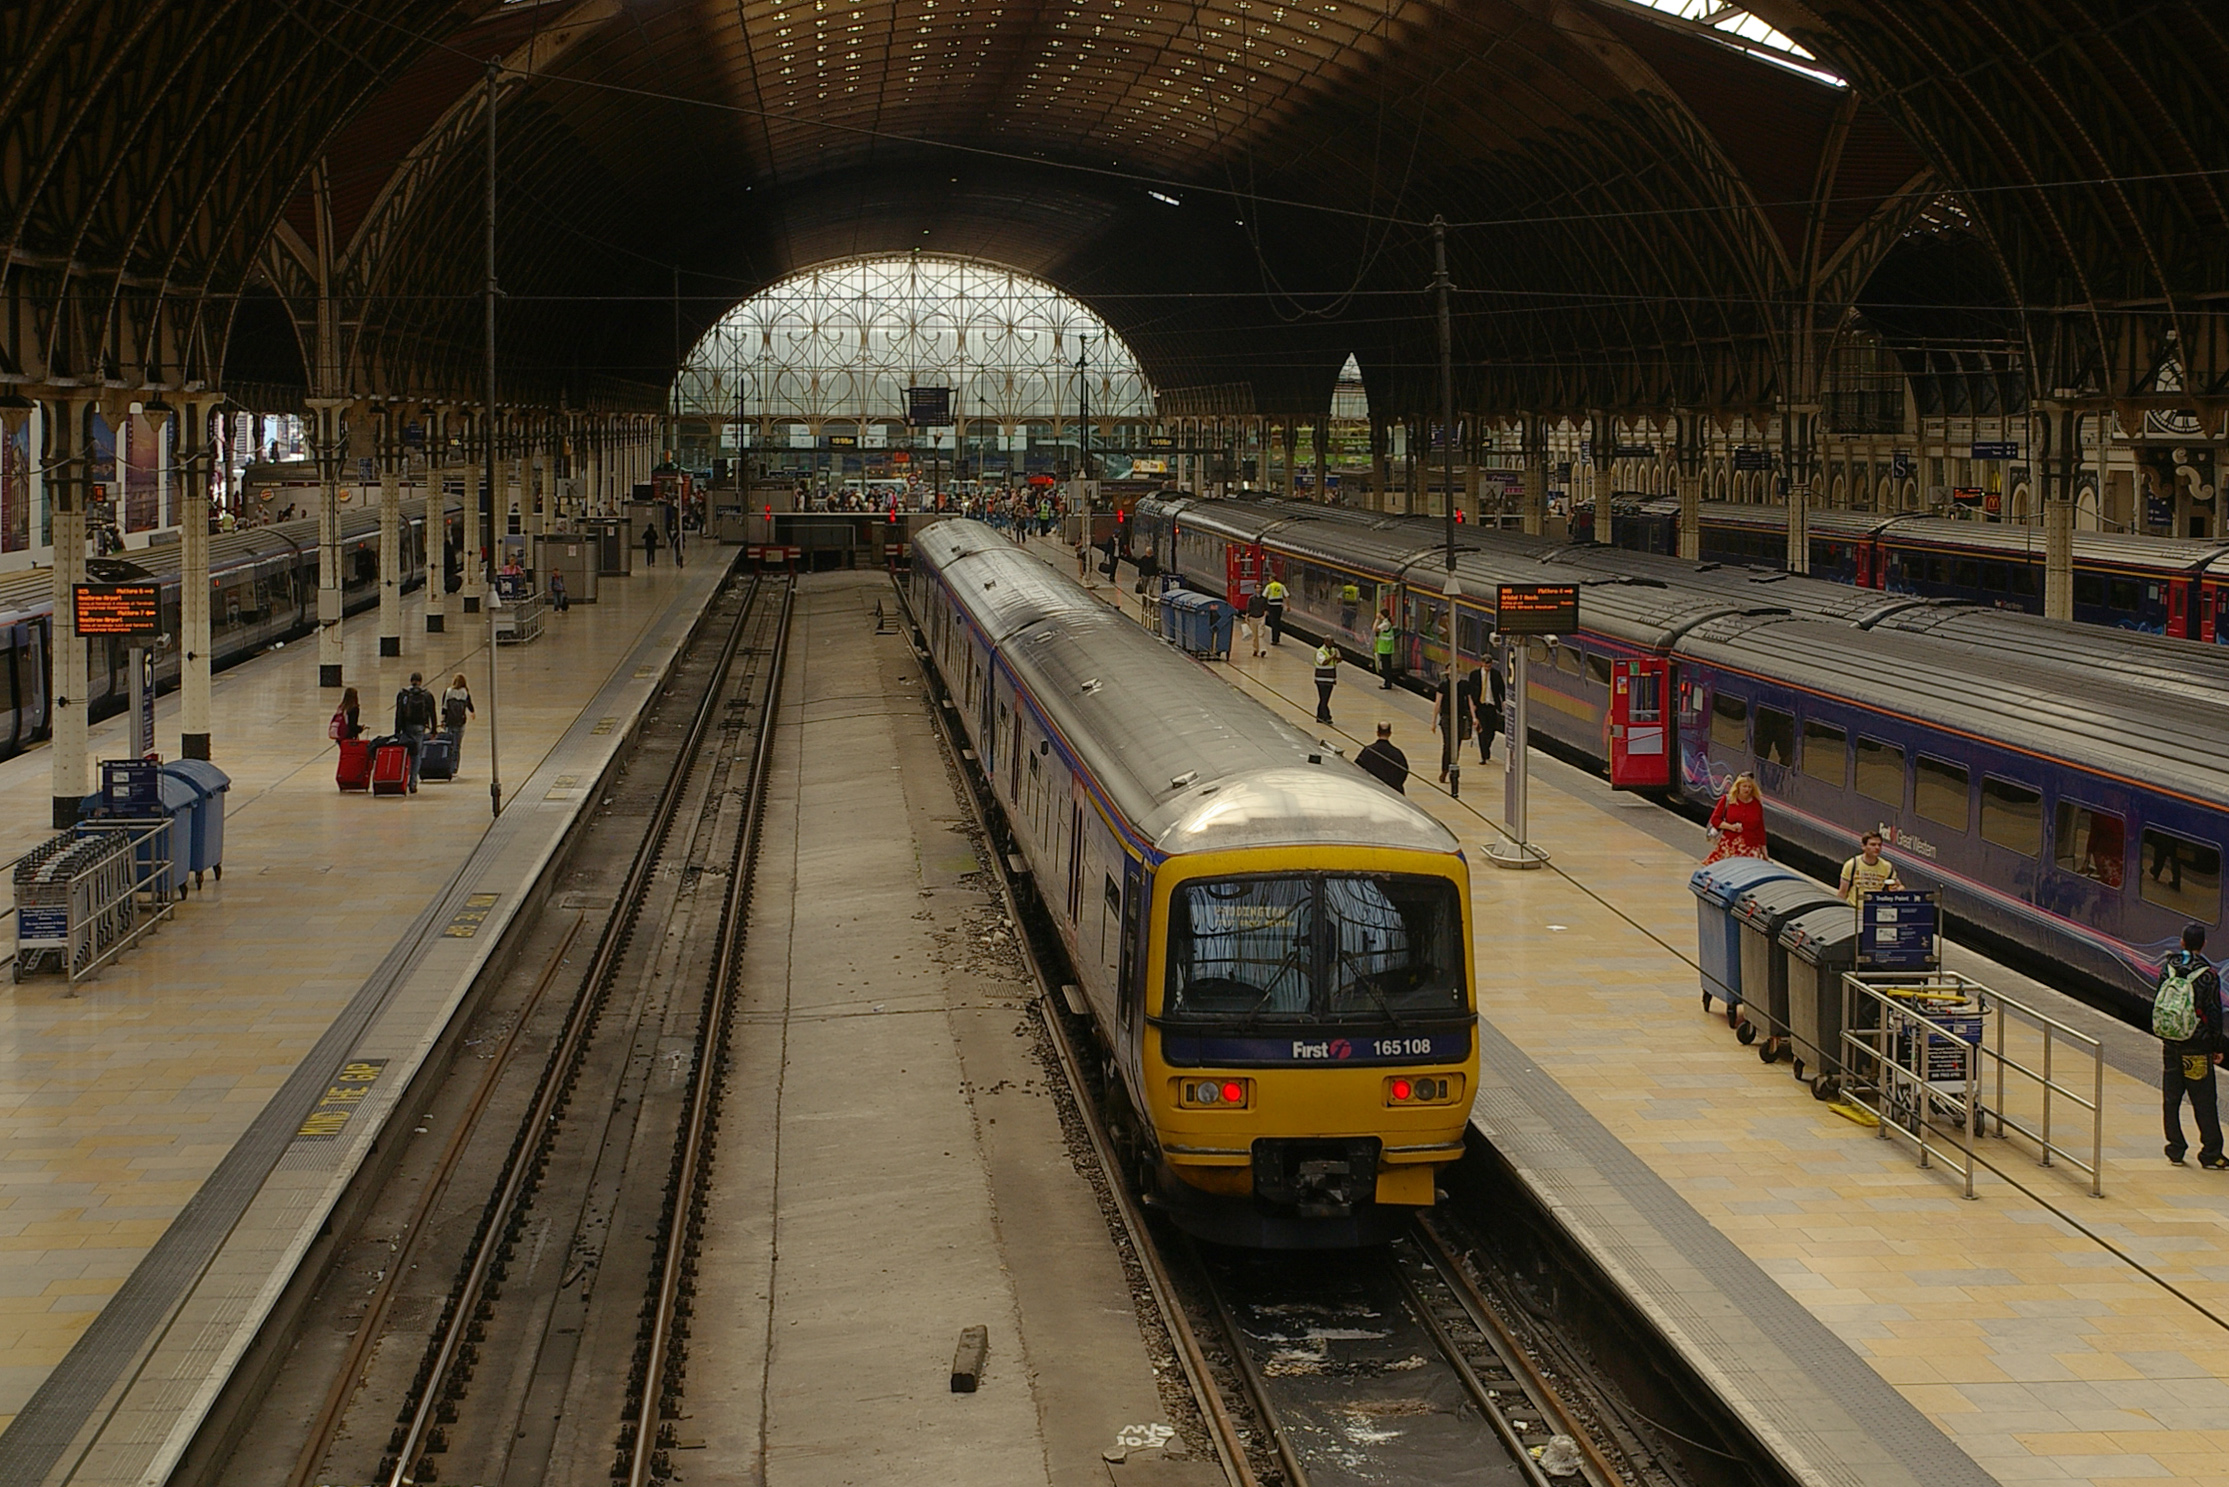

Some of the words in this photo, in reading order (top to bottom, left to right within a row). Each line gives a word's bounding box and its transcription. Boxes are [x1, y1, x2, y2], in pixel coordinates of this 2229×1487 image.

[145, 653, 153, 688] 6
[1292, 1041, 1330, 1059] First
[1373, 1038, 1432, 1057] 165108
[338, 1062, 382, 1082] GAP
[320, 1086, 369, 1107] THE
[297, 1110, 351, 1137] MIND
